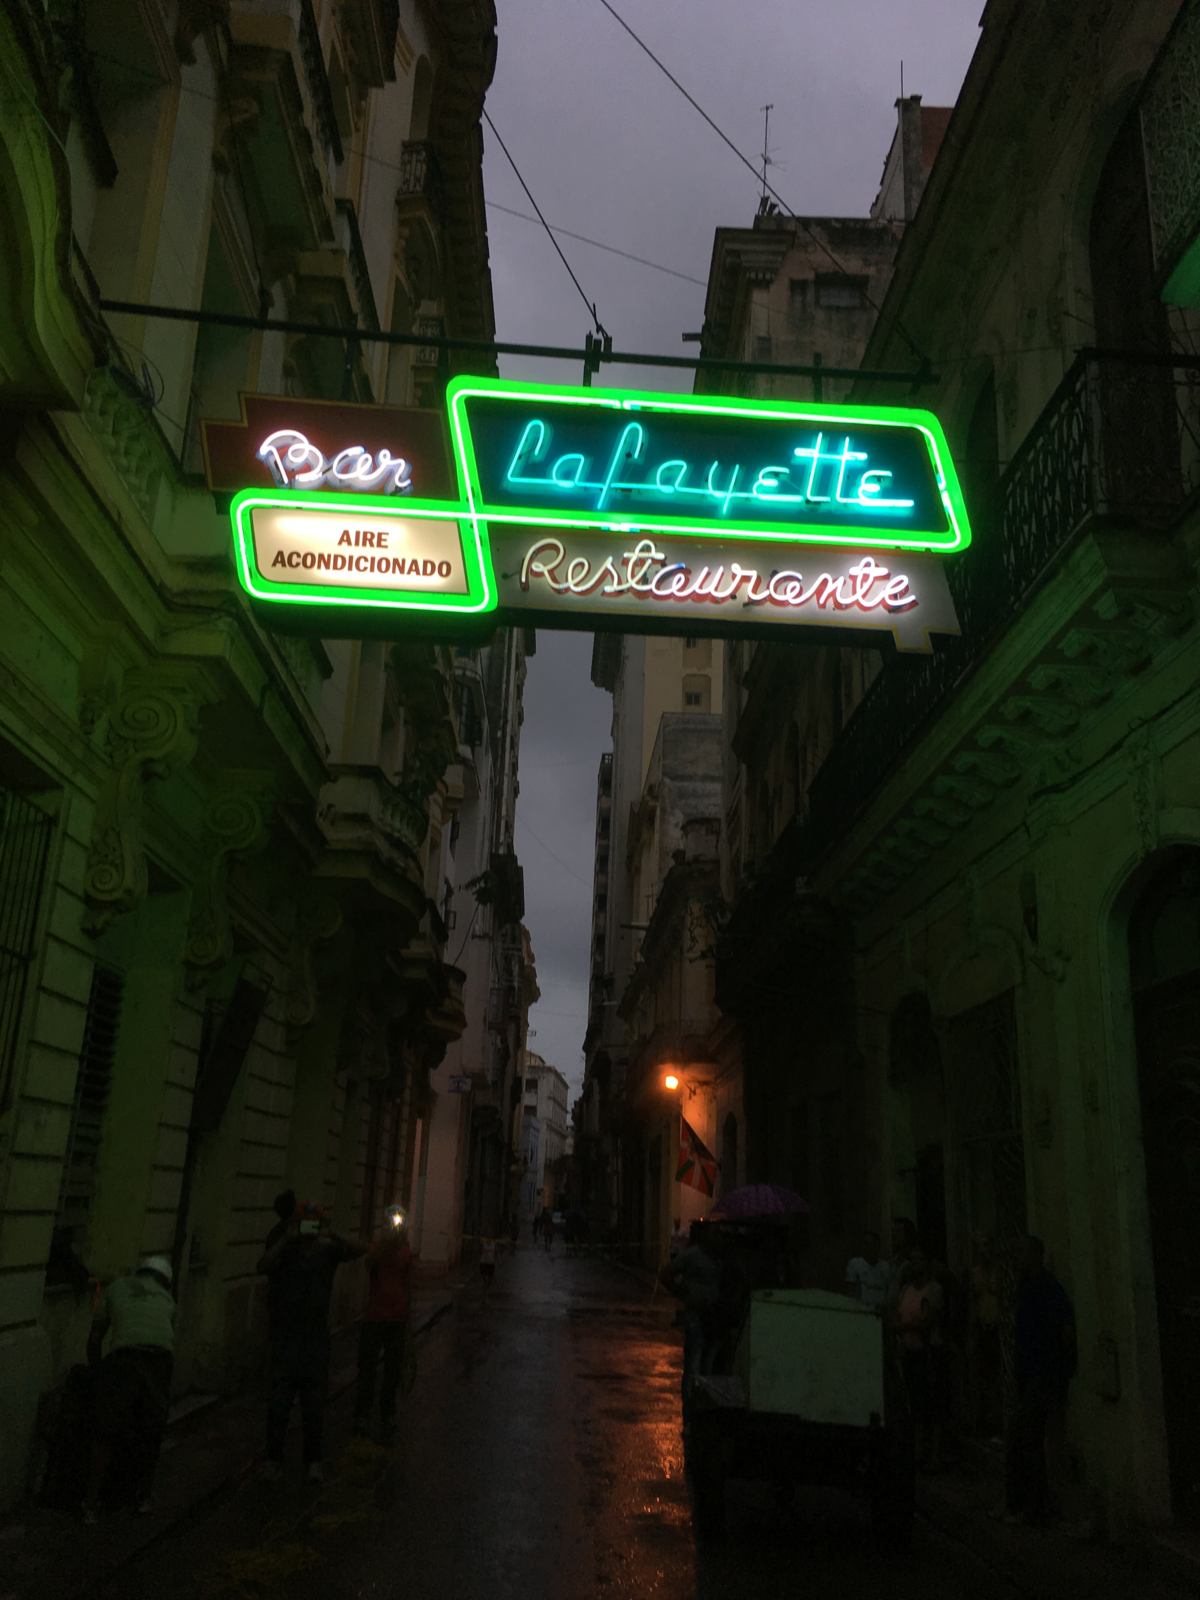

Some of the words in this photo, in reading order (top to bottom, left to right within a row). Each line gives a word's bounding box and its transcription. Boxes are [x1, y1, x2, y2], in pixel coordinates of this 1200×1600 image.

[256, 429, 413, 496] Bar
[505, 418, 915, 516] Lafayette
[271, 550, 452, 578] ACONDICIONADO
[337, 529, 389, 549] AIRE
[519, 537, 918, 613] Restaurante
